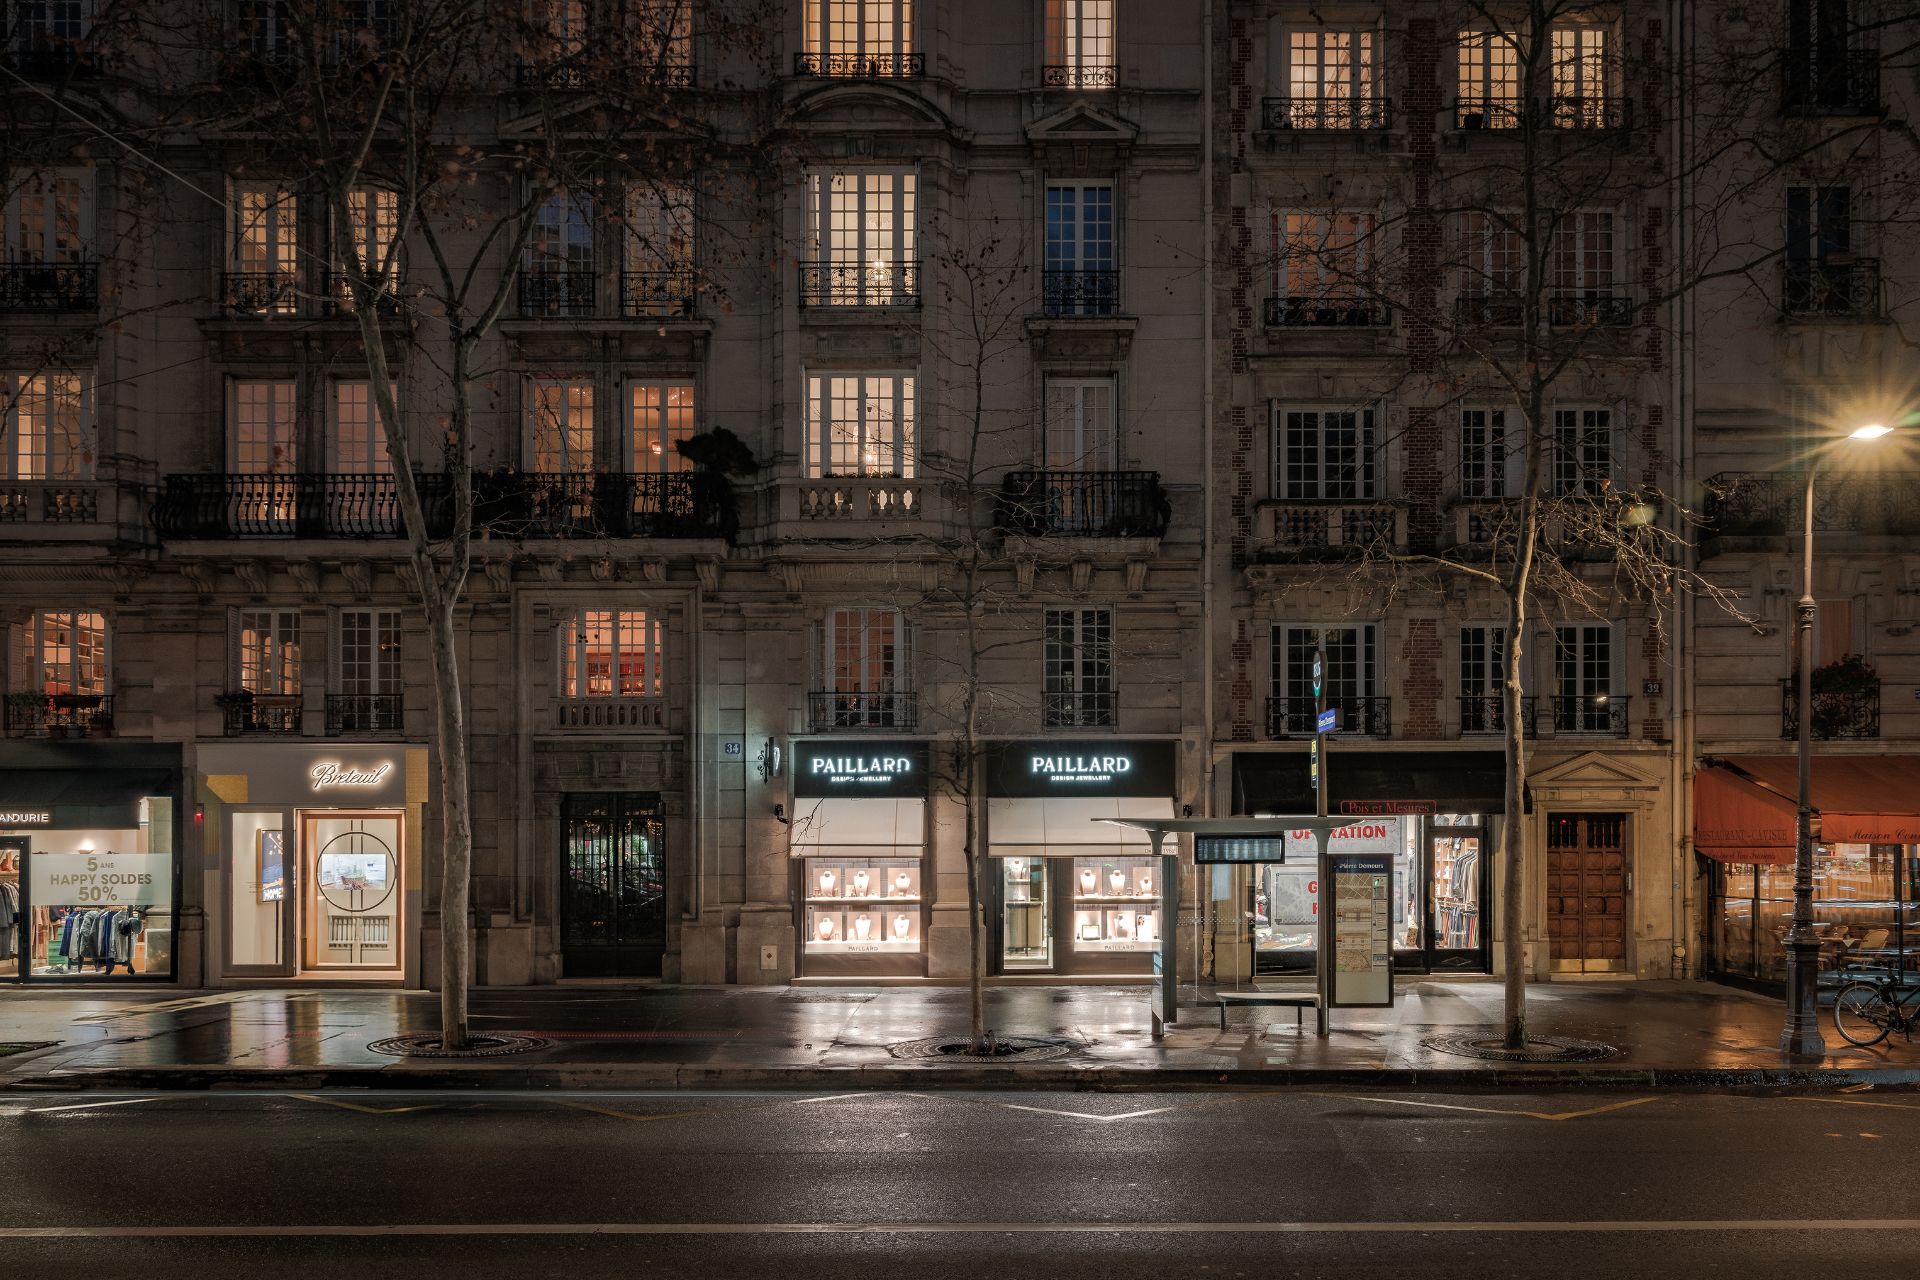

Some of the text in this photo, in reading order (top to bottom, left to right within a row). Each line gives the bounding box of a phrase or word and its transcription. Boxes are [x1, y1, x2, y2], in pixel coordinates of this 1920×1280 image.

[1647, 683, 1660, 693] 32
[726, 743, 739, 753] 34
[812, 758, 911, 773] PAILLARD
[1032, 757, 1130, 772] PAILLARD
[312, 764, 389, 788] Breteuil
[1372, 805, 1382, 813] et
[1386, 802, 1430, 813] Mesures
[1848, 829, 1891, 840] Maison
[87, 857, 98, 872] 5
[50, 873, 152, 885] HAPPY SOLDES
[78, 886, 118, 902] 50%
